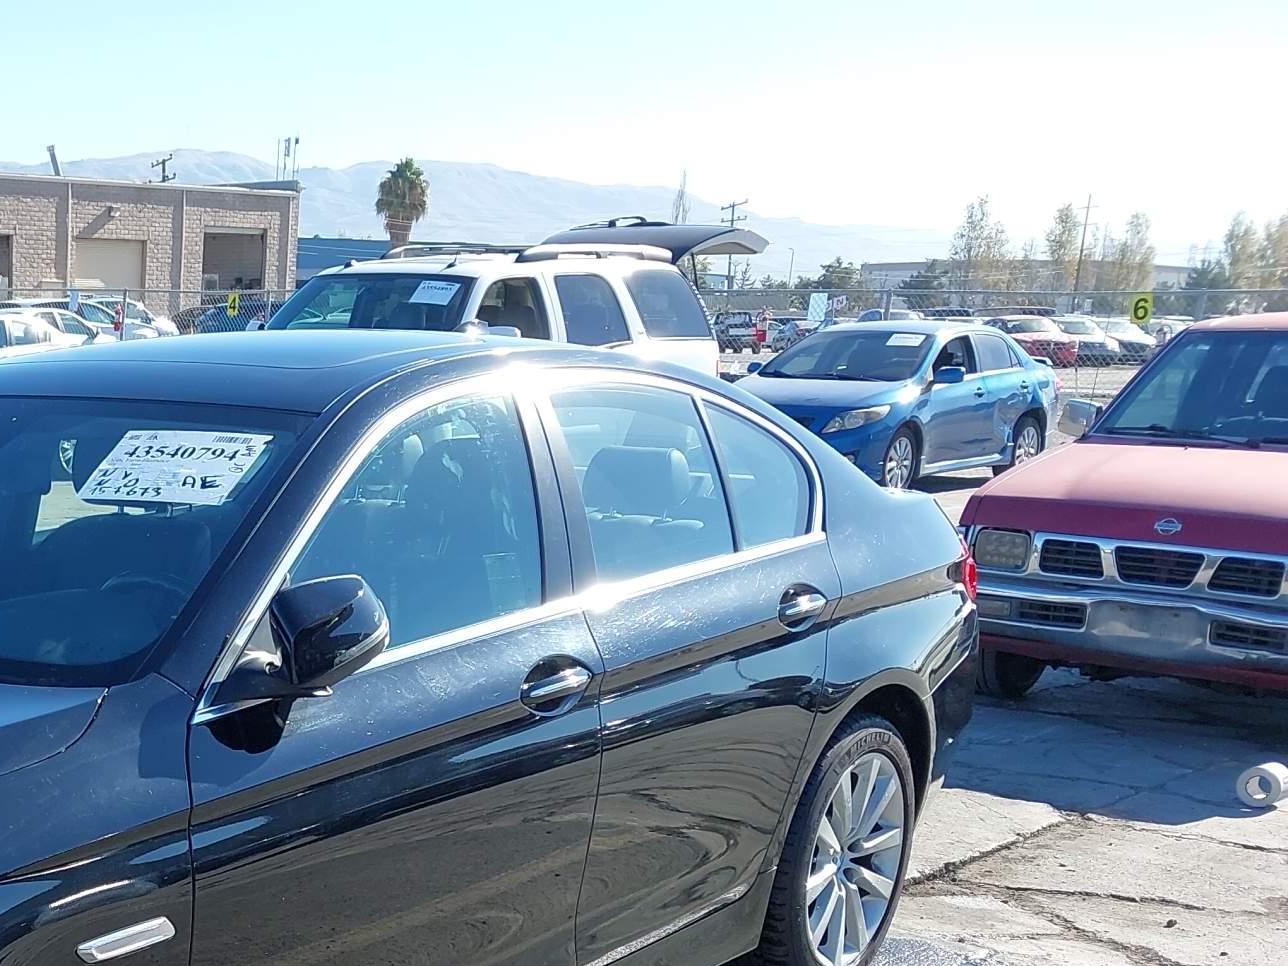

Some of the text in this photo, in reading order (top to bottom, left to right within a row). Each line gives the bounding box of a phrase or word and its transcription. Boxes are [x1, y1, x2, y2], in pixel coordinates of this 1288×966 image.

[228, 296, 237, 312] 4
[1133, 297, 1149, 320] 6
[124, 445, 241, 461] 43540794
